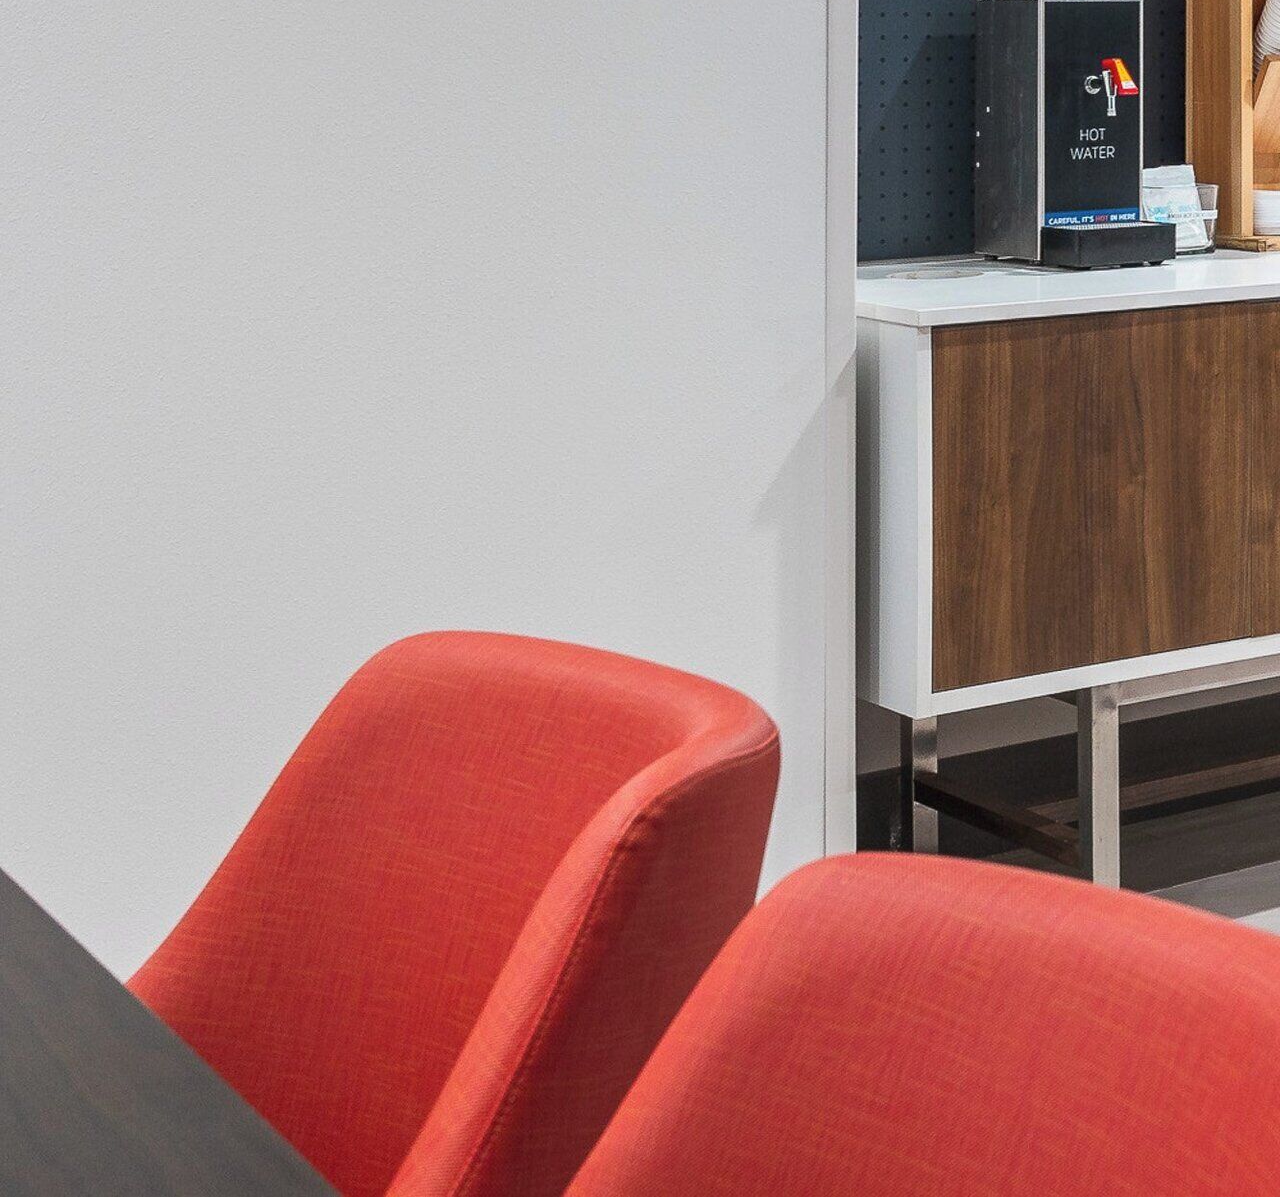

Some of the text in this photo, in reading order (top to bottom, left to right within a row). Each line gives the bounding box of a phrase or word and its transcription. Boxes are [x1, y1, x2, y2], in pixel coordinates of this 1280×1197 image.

[1079, 128, 1107, 141] HOT
[1070, 146, 1116, 160] WATER
[1095, 214, 1109, 222] HOT
[1110, 213, 1118, 221] IN
[1118, 212, 1136, 221] HERE
